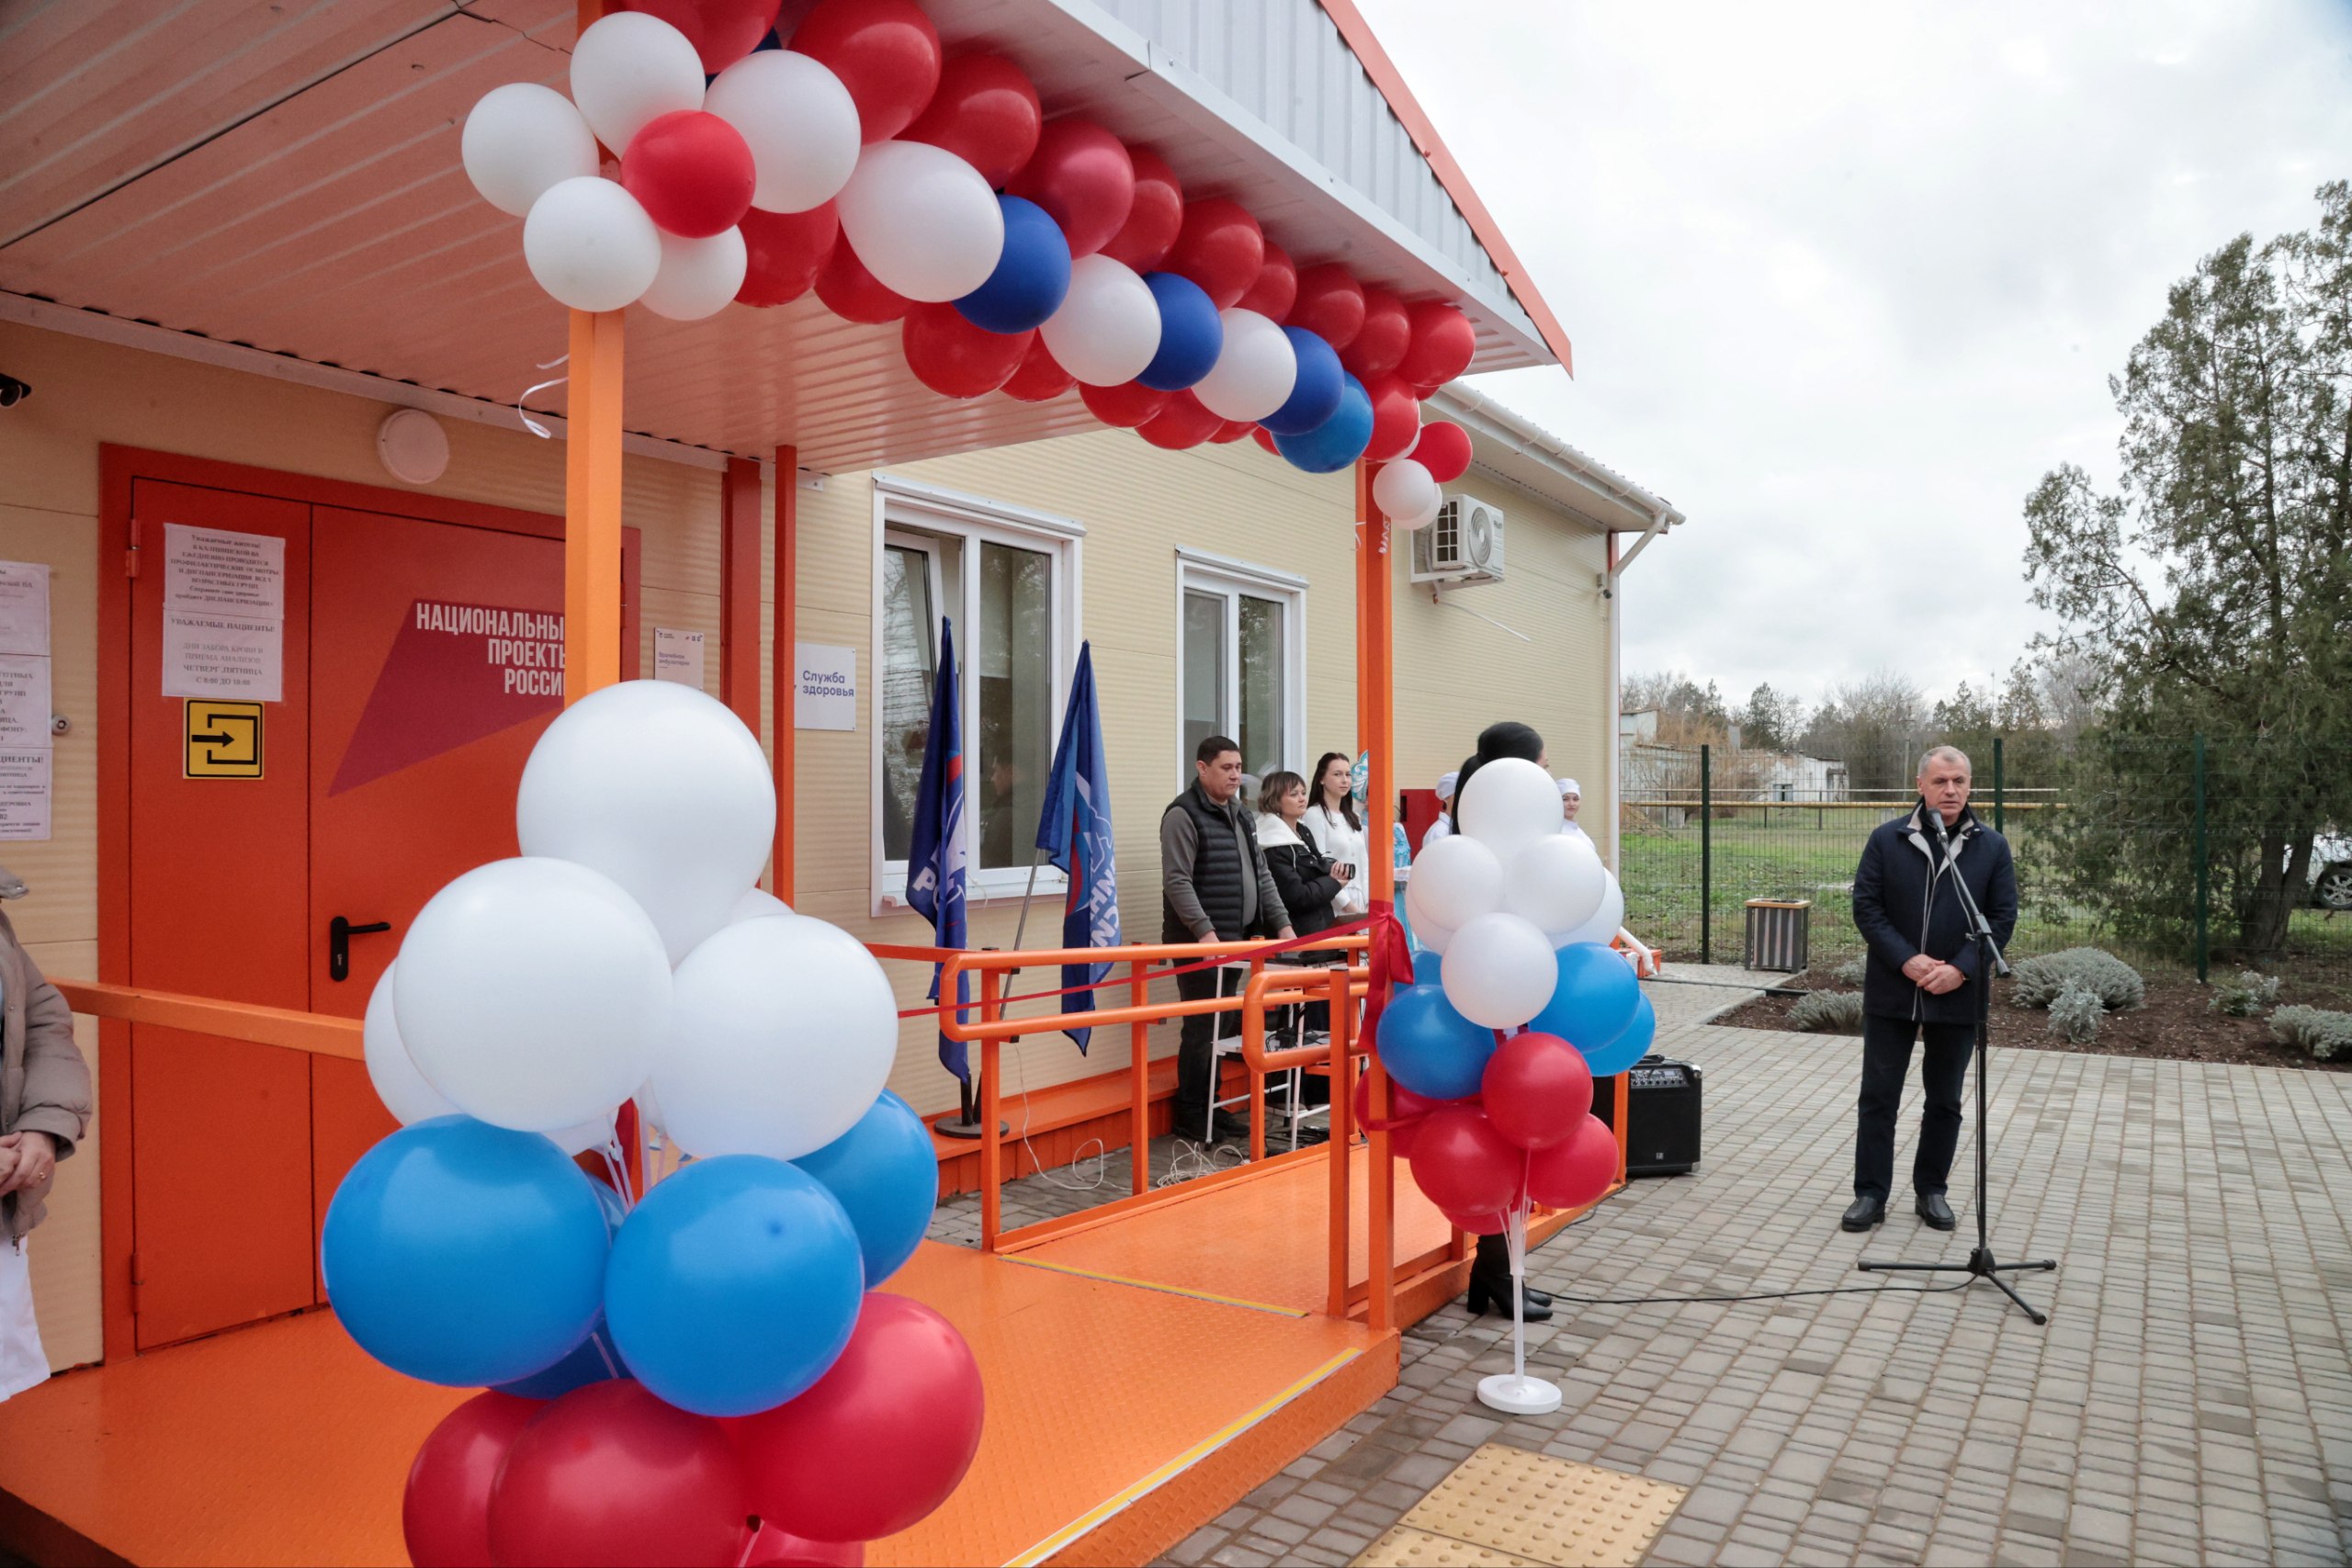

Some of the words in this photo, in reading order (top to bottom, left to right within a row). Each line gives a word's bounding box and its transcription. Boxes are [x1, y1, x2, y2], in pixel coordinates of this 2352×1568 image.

[416, 603, 565, 641] НАЦИОНАЛЬНЫ
[504, 668, 565, 696] РОССИ
[802, 670, 845, 684] Служба
[802, 685, 854, 698] здоровья
